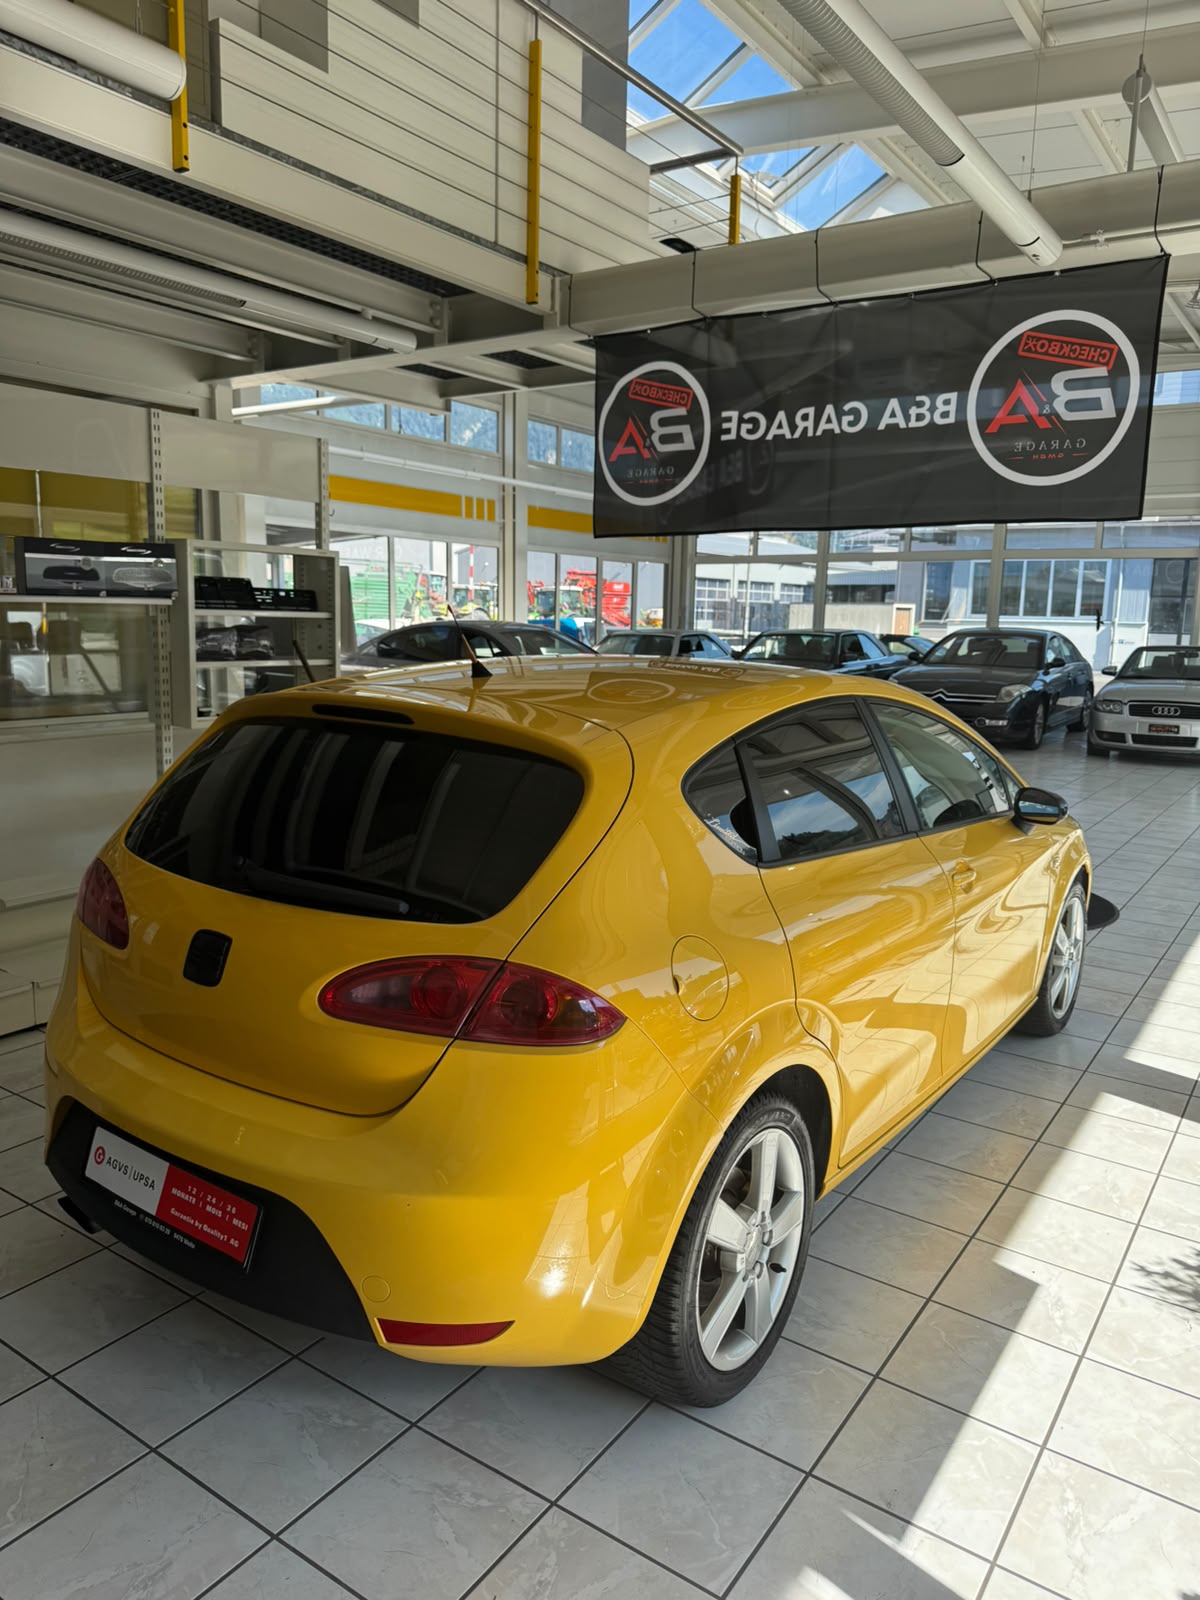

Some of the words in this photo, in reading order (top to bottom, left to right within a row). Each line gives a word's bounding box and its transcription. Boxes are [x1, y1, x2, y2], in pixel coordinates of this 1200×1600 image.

[187, 1185, 197, 1195] 12
[206, 1194, 217, 1204] 24
[171, 1187, 196, 1204] MONATE
[205, 1204, 223, 1218] MOIS
[232, 1218, 249, 1231] MESI
[194, 1220, 203, 1230] by
[202, 1224, 228, 1241] Quality1
[229, 1238, 240, 1248] AG
